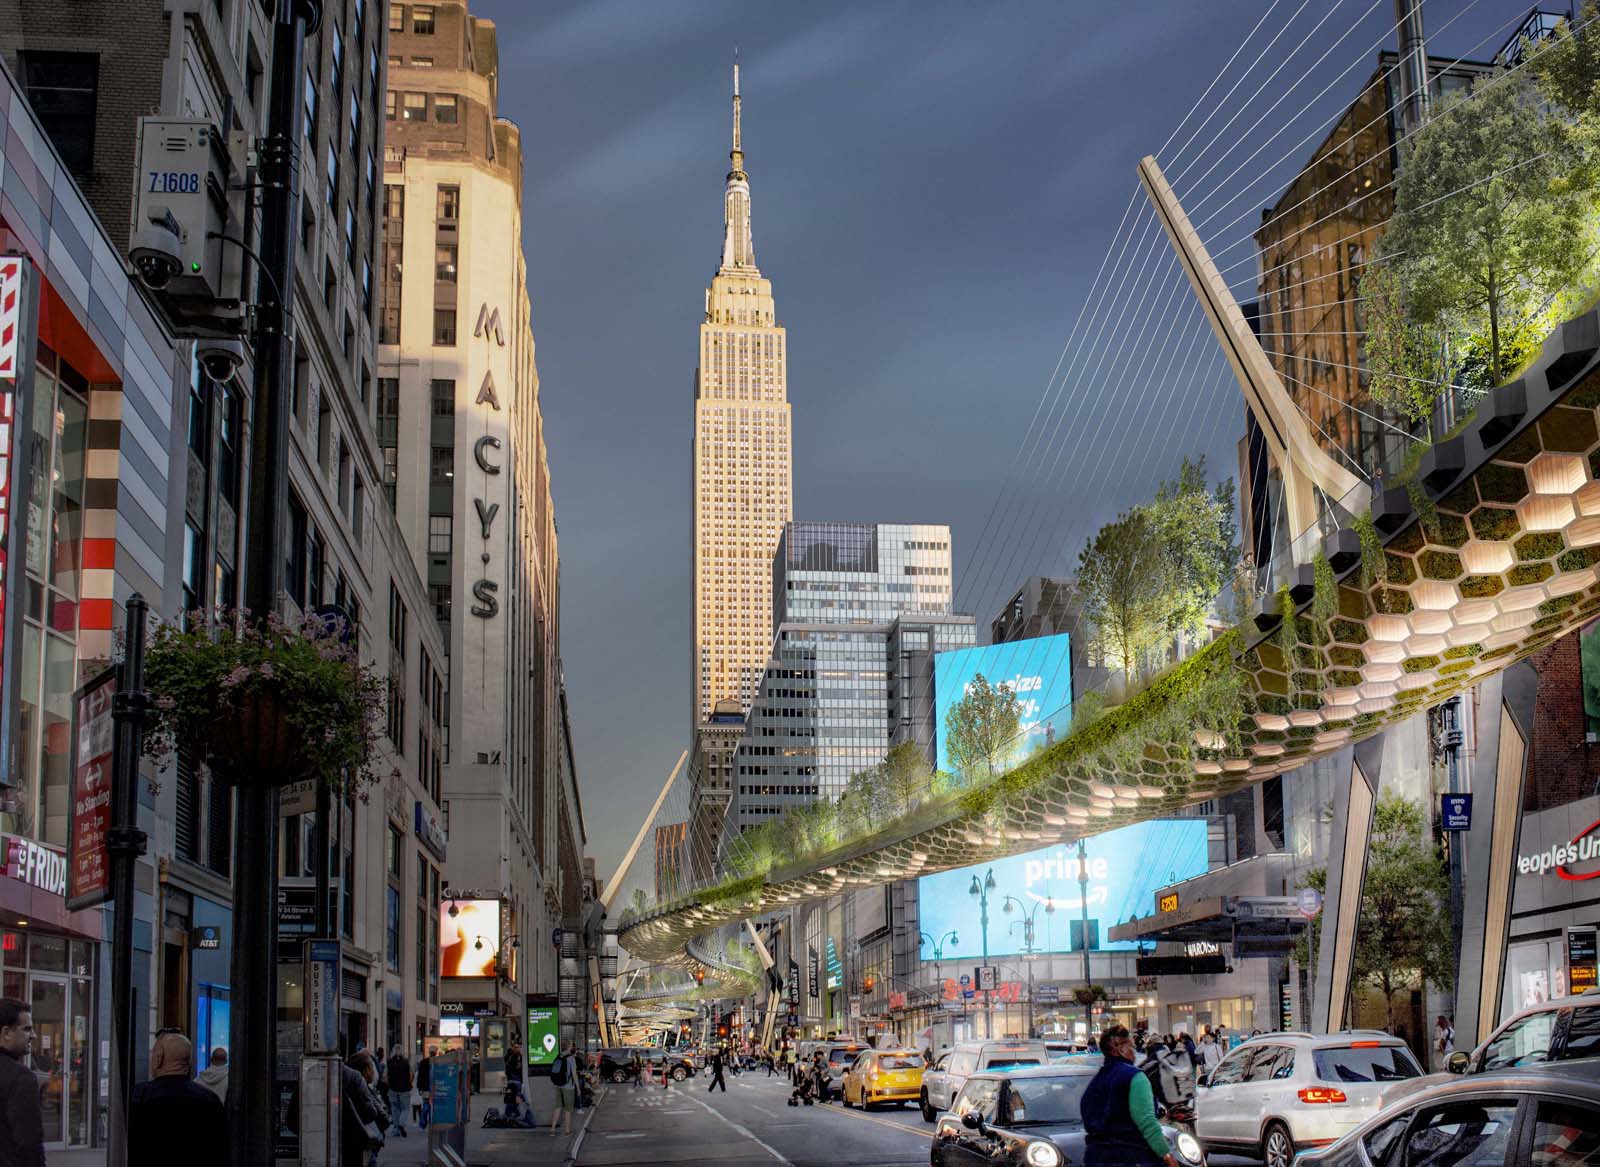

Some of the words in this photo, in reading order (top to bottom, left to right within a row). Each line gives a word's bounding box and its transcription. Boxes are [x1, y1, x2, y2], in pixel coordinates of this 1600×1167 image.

[1025, 851, 1108, 887] prime
[199, 939, 218, 947] AT&T
[810, 981, 818, 997] OLD
